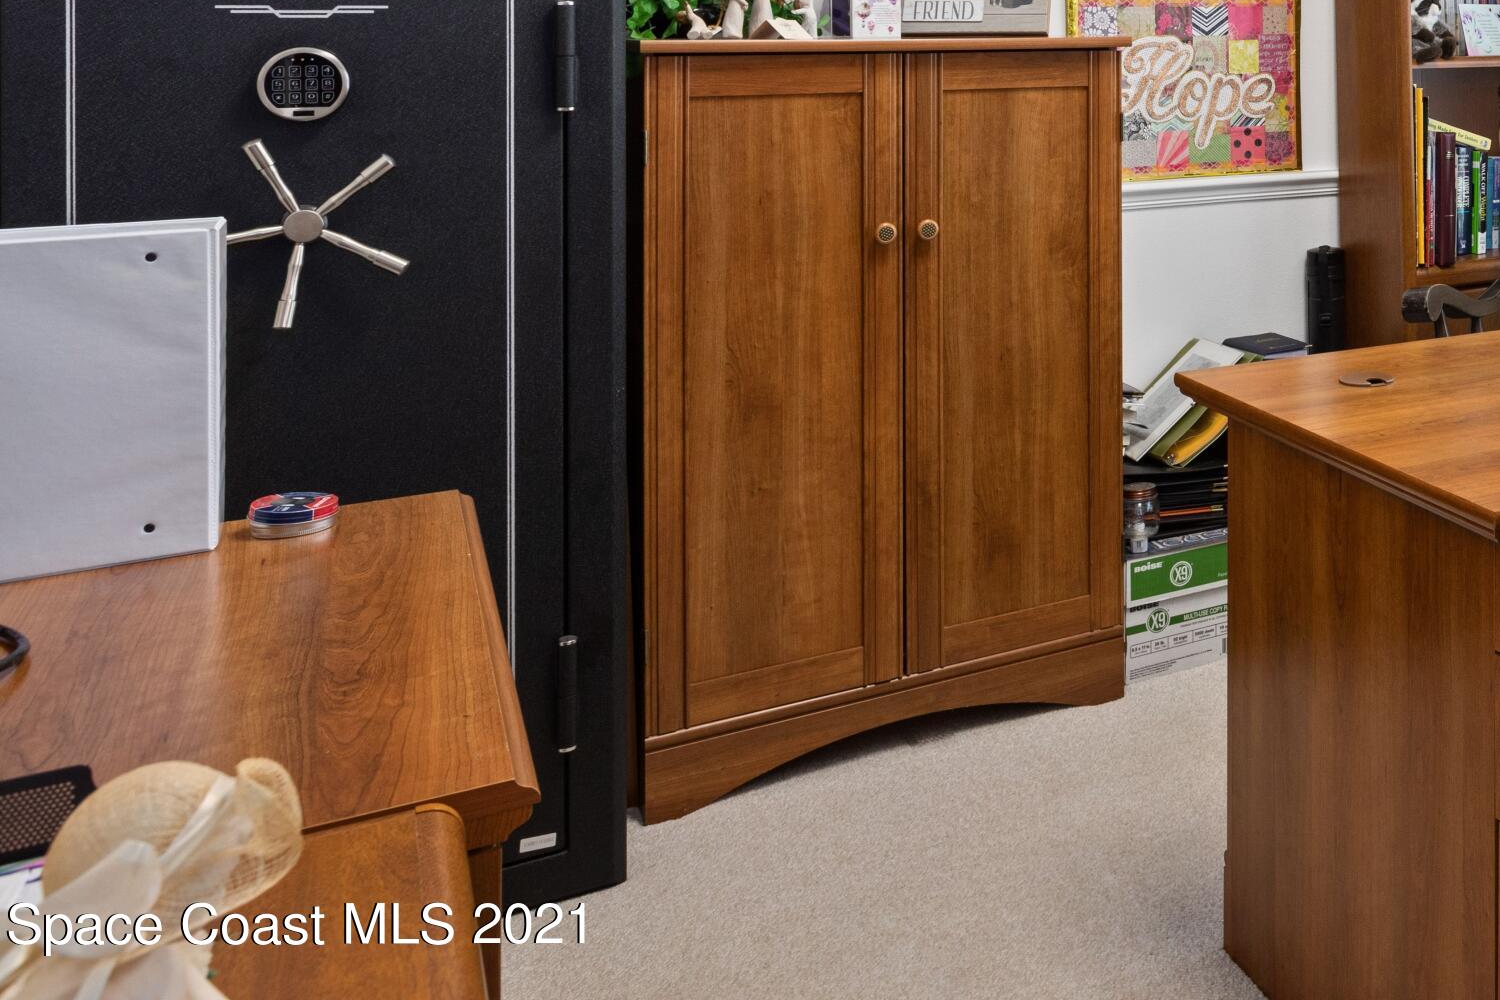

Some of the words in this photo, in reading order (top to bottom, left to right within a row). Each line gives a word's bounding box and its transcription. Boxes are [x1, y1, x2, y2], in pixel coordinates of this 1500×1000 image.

[913, 0, 975, 20] FRIEND
[1121, 36, 1275, 149] Hope
[1174, 565, 1188, 581] X9
[1151, 612, 1166, 630] X9
[1183, 610, 1209, 621] MULTI-USE
[1209, 607, 1224, 616] COPY
